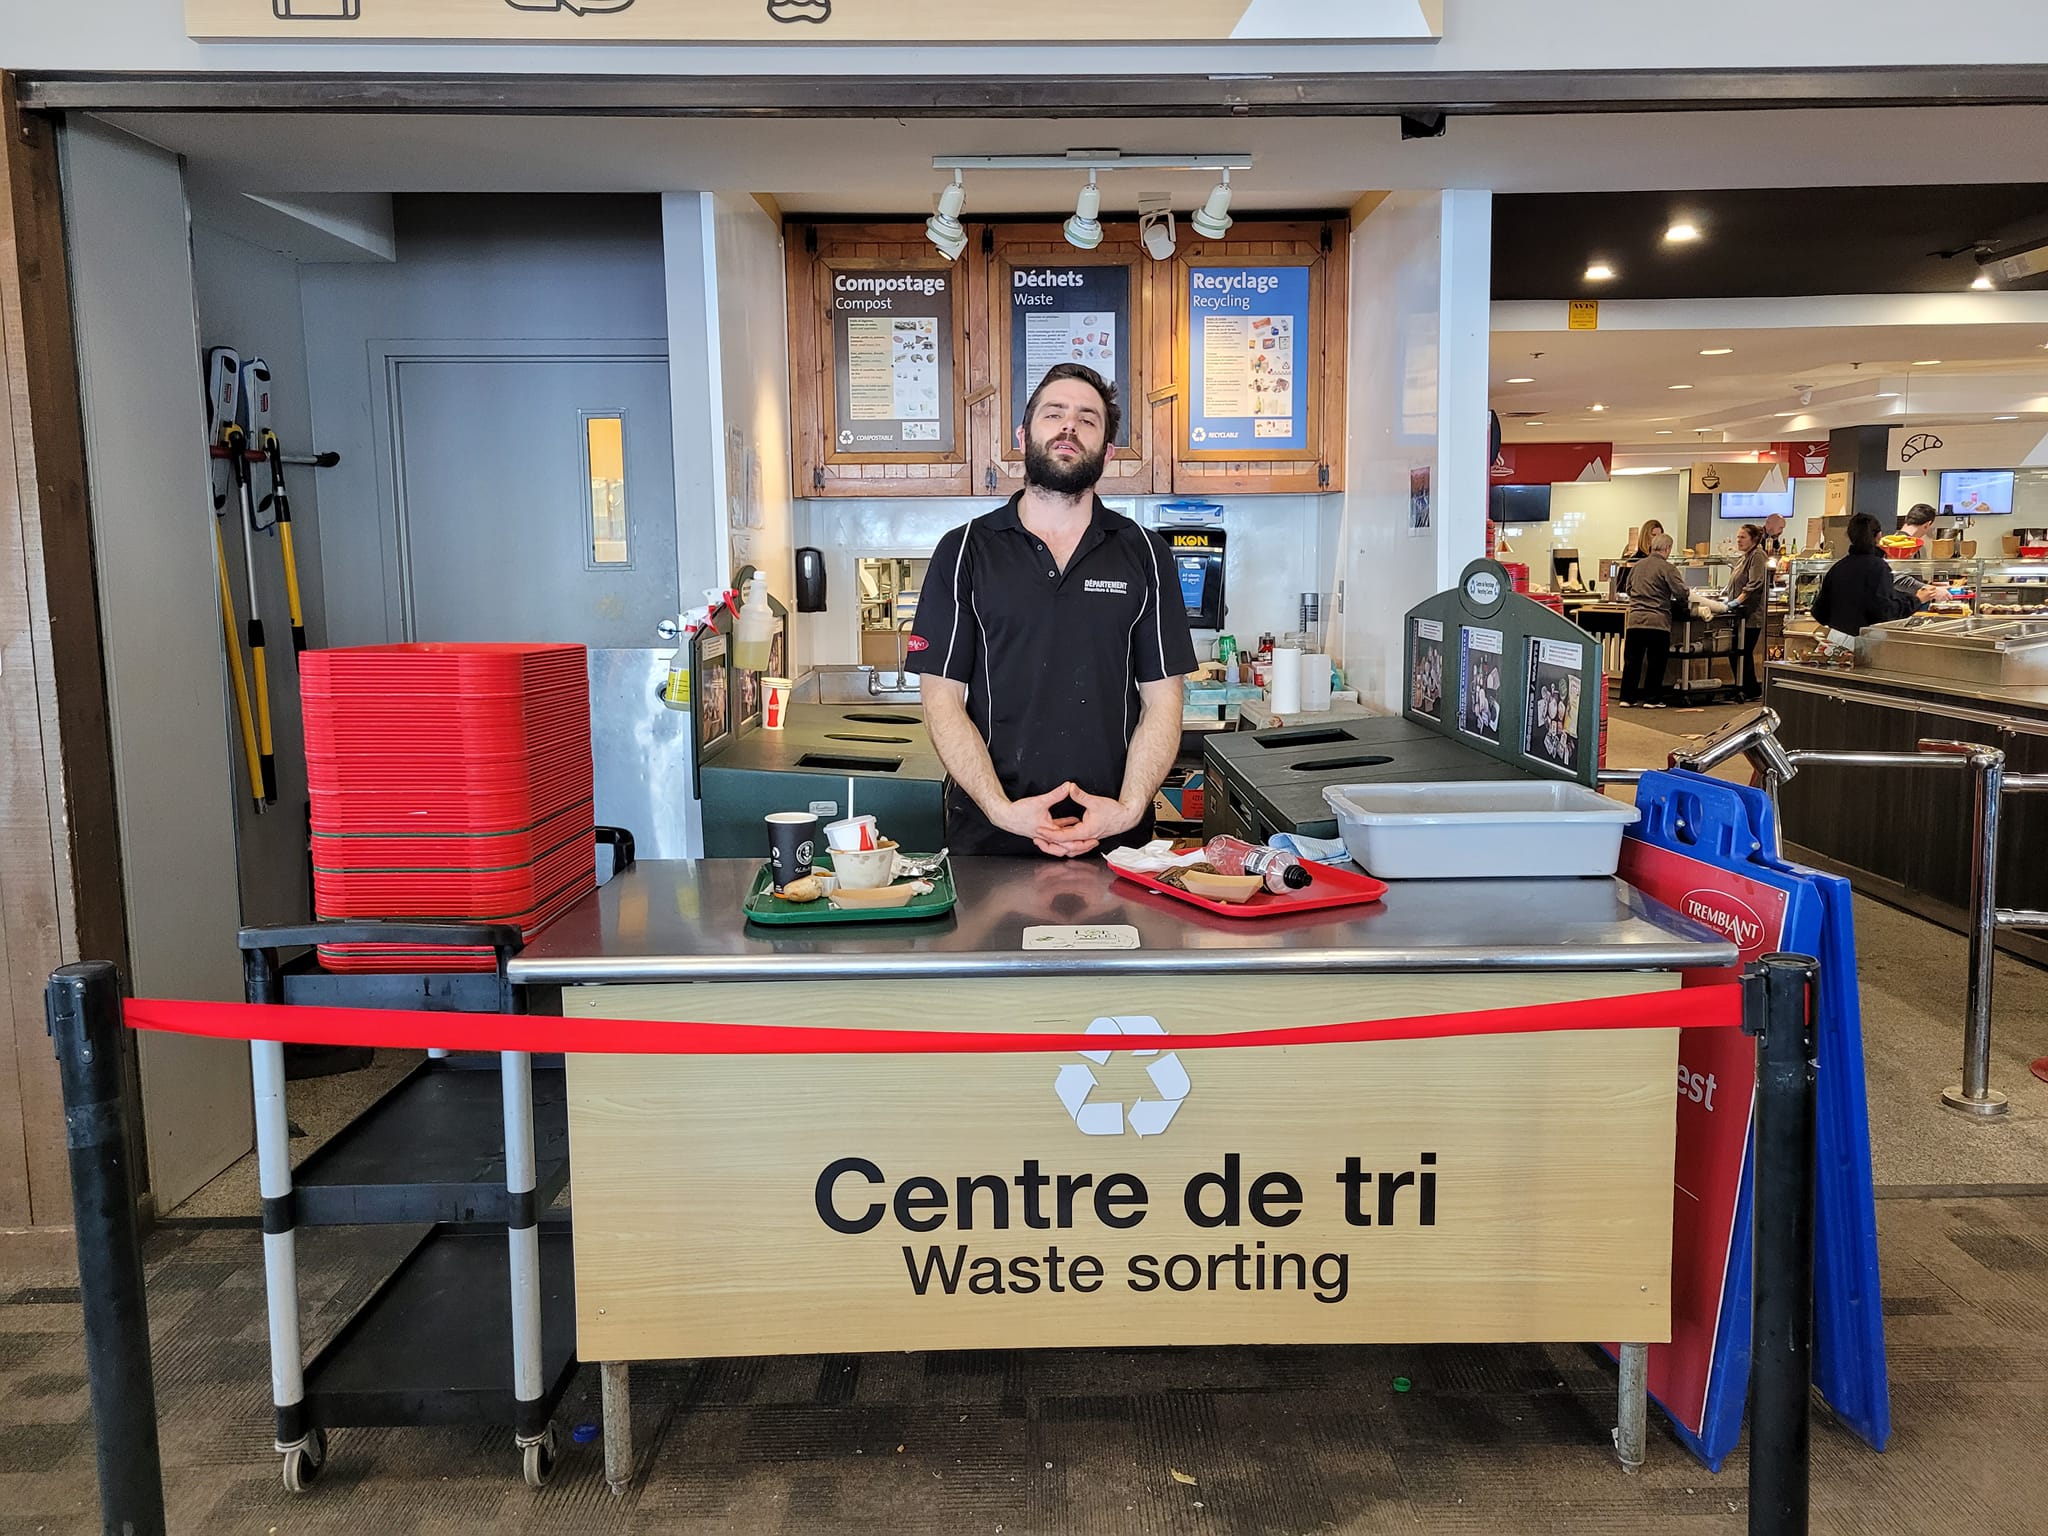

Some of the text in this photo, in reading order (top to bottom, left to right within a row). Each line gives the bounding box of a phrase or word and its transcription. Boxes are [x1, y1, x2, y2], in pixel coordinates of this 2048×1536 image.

[835, 275, 945, 296] Compostage
[1014, 270, 1084, 287] Déchets
[1193, 272, 1279, 293] Recyclage
[835, 297, 892, 313] Compost
[1014, 293, 1054, 305] Waste
[1193, 294, 1250, 311] Recycling
[1173, 535, 1208, 546] IKON
[1084, 579, 1127, 590] DÉPARTEMENT
[1688, 899, 1760, 946] TREMBLANT
[814, 1151, 1437, 1234] Centre de tri
[901, 1240, 1350, 1304] Waste sorting
